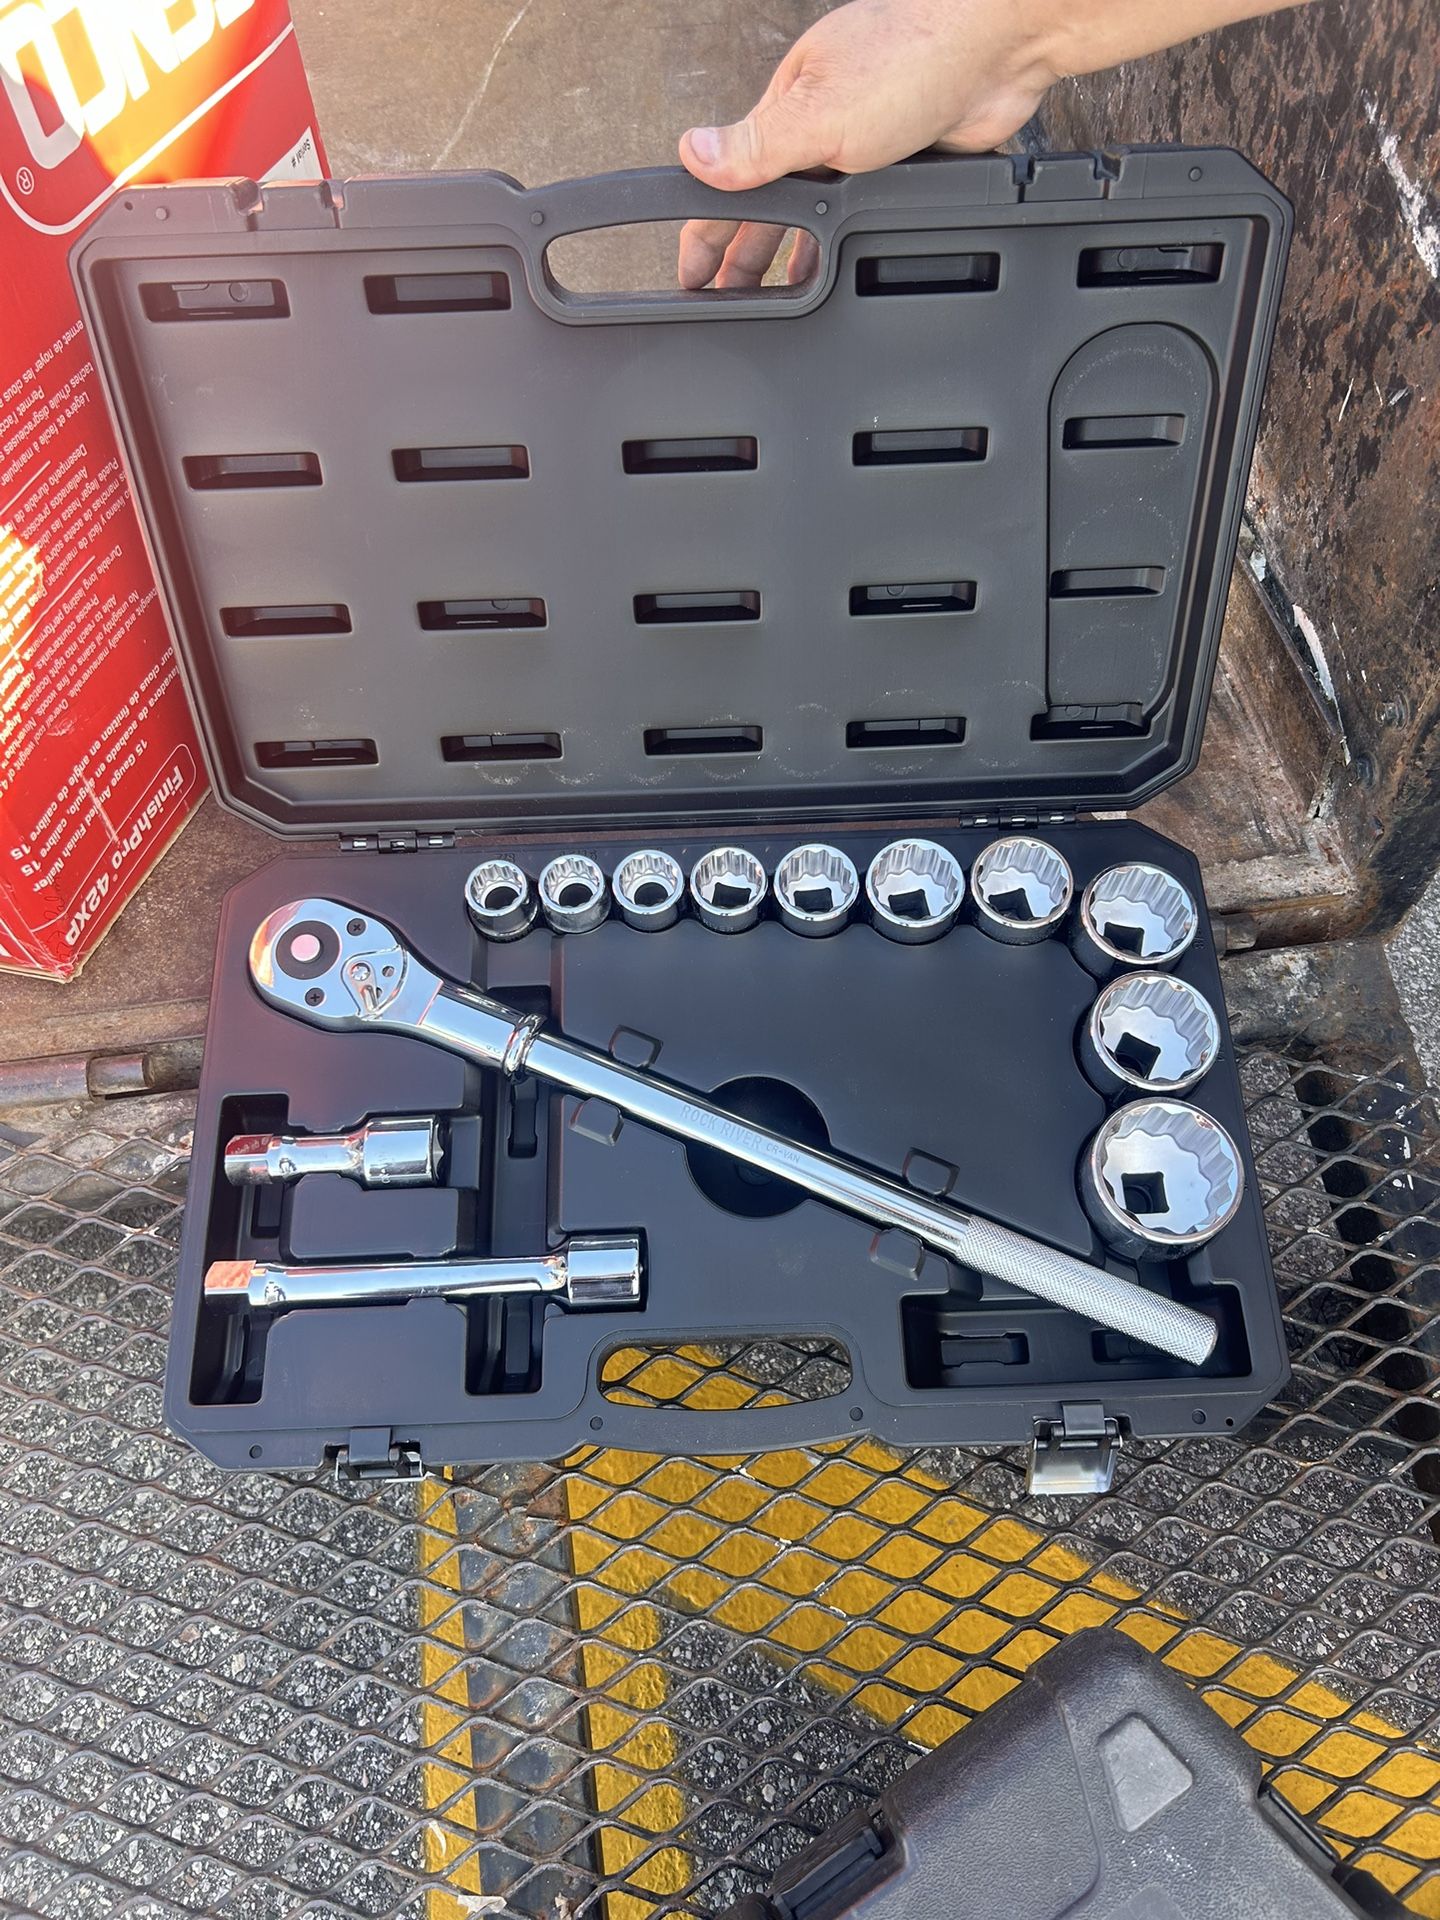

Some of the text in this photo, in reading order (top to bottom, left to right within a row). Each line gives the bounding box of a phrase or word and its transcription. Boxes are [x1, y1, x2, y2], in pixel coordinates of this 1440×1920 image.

[2, 319, 84, 402] ermet de noyer les clous
[3, 361, 94, 456] taches d'huile disgracieuses
[16, 385, 45, 417] Permet
[64, 391, 90, 418] Légère
[56, 414, 66, 428] et
[38, 422, 59, 446] facile
[32, 441, 41, 453] à
[48, 443, 88, 486] Desempeño
[23, 482, 50, 513] durable
[49, 466, 88, 510] Avellanados
[50, 457, 119, 533] Puede llegar hasta las
[91, 478, 120, 512] manchas
[13, 509, 25, 524] de
[82, 508, 93, 522] de
[100, 514, 107, 526] y
[105, 495, 126, 520] liviano
[63, 518, 84, 543] aceite
[77, 536, 89, 550] de
[87, 521, 103, 543] fácil
[44, 539, 65, 564] sobre
[96, 544, 123, 575] Durable
[82, 571, 99, 590] long
[62, 587, 87, 615] lasting
[75, 593, 100, 624] Precise
[101, 594, 117, 614] Able
[127, 590, 140, 604] No
[94, 610, 104, 623] to
[102, 600, 130, 635] unsightly
[124, 612, 137, 632] and
[76, 619, 96, 644] reach
[95, 631, 104, 646] oil
[107, 626, 126, 650] easily
[64, 640, 79, 659] into
[76, 641, 97, 666] stains
[48, 656, 67, 678] tight
[67, 663, 78, 677] on
[55, 674, 71, 692] fine
[147, 665, 183, 708] lavadora
[137, 706, 149, 721] de
[10, 646, 178, 860] our clous de finition en angle de calibre 15
[105, 720, 138, 764] acabado
[135, 739, 148, 757] 15
[13, 740, 36, 771] weight
[7, 768, 16, 783] of
[94, 762, 107, 778] en
[110, 753, 136, 787] Gauge
[84, 785, 112, 827] Angled
[39, 818, 68, 858] calibre
[61, 823, 87, 858] Finish
[20, 860, 41, 877] 15
[33, 857, 65, 892] Nailer
[65, 873, 109, 946] 42XP
[680, 1104, 801, 1164] ROCK RIVER CR-VAN
